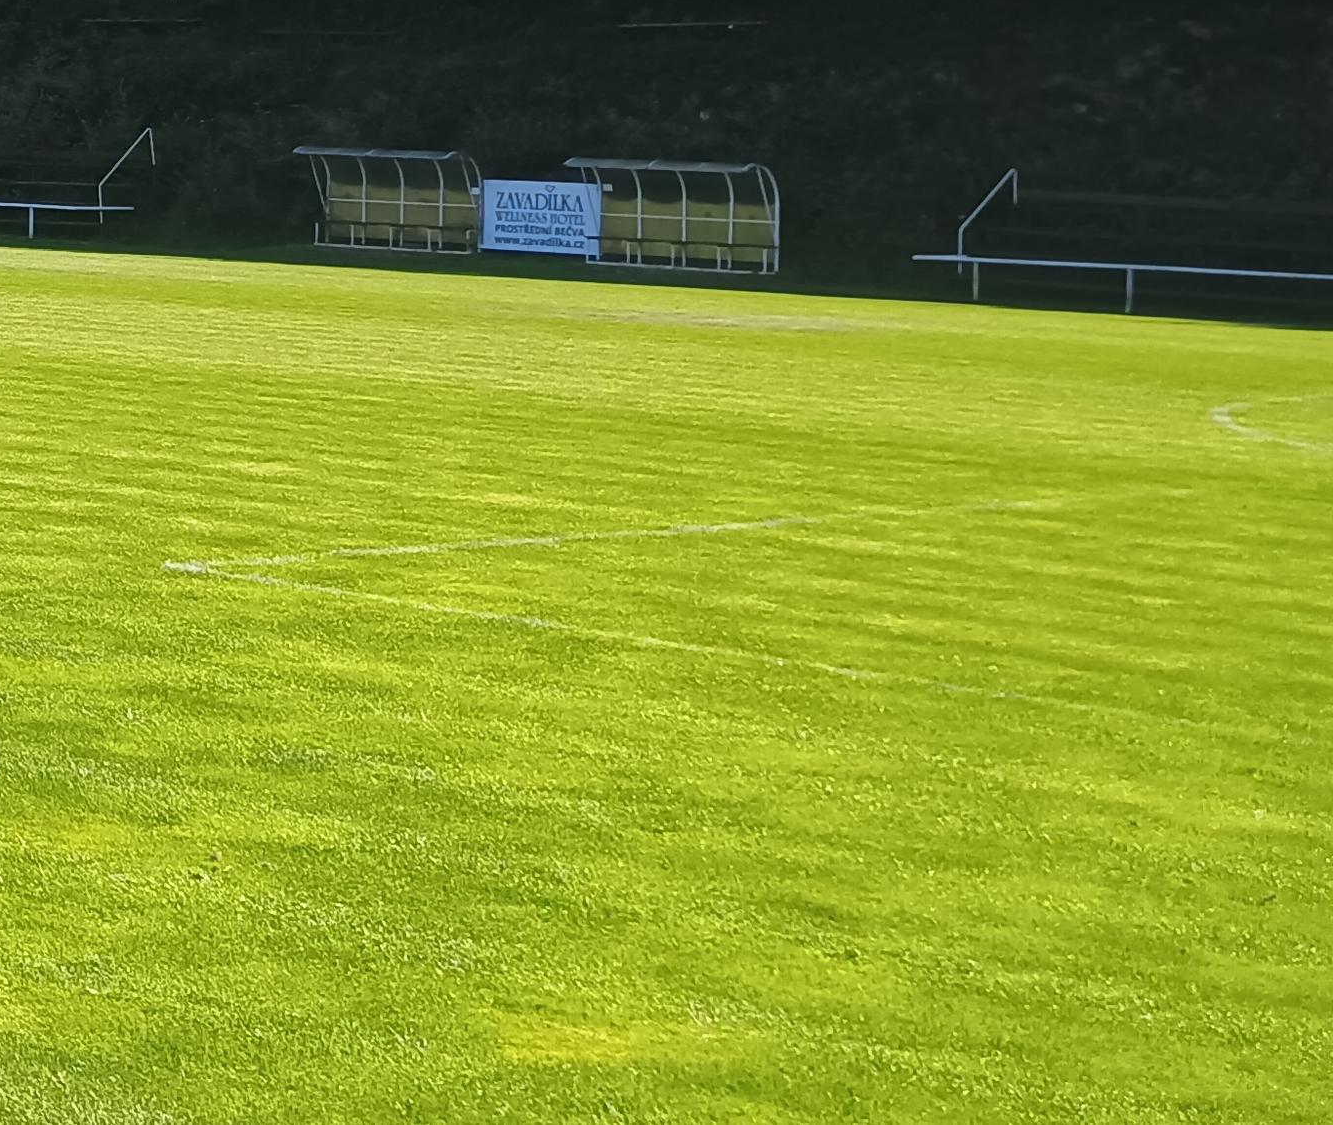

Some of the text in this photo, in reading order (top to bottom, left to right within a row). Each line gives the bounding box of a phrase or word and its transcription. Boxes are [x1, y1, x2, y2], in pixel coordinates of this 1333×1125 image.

[495, 211, 586, 226] WELLNESS HOTEL
[495, 224, 585, 237] PROSTŘEDNÍ BEČVA
[494, 236, 585, 249] www.zavadilka.cz
